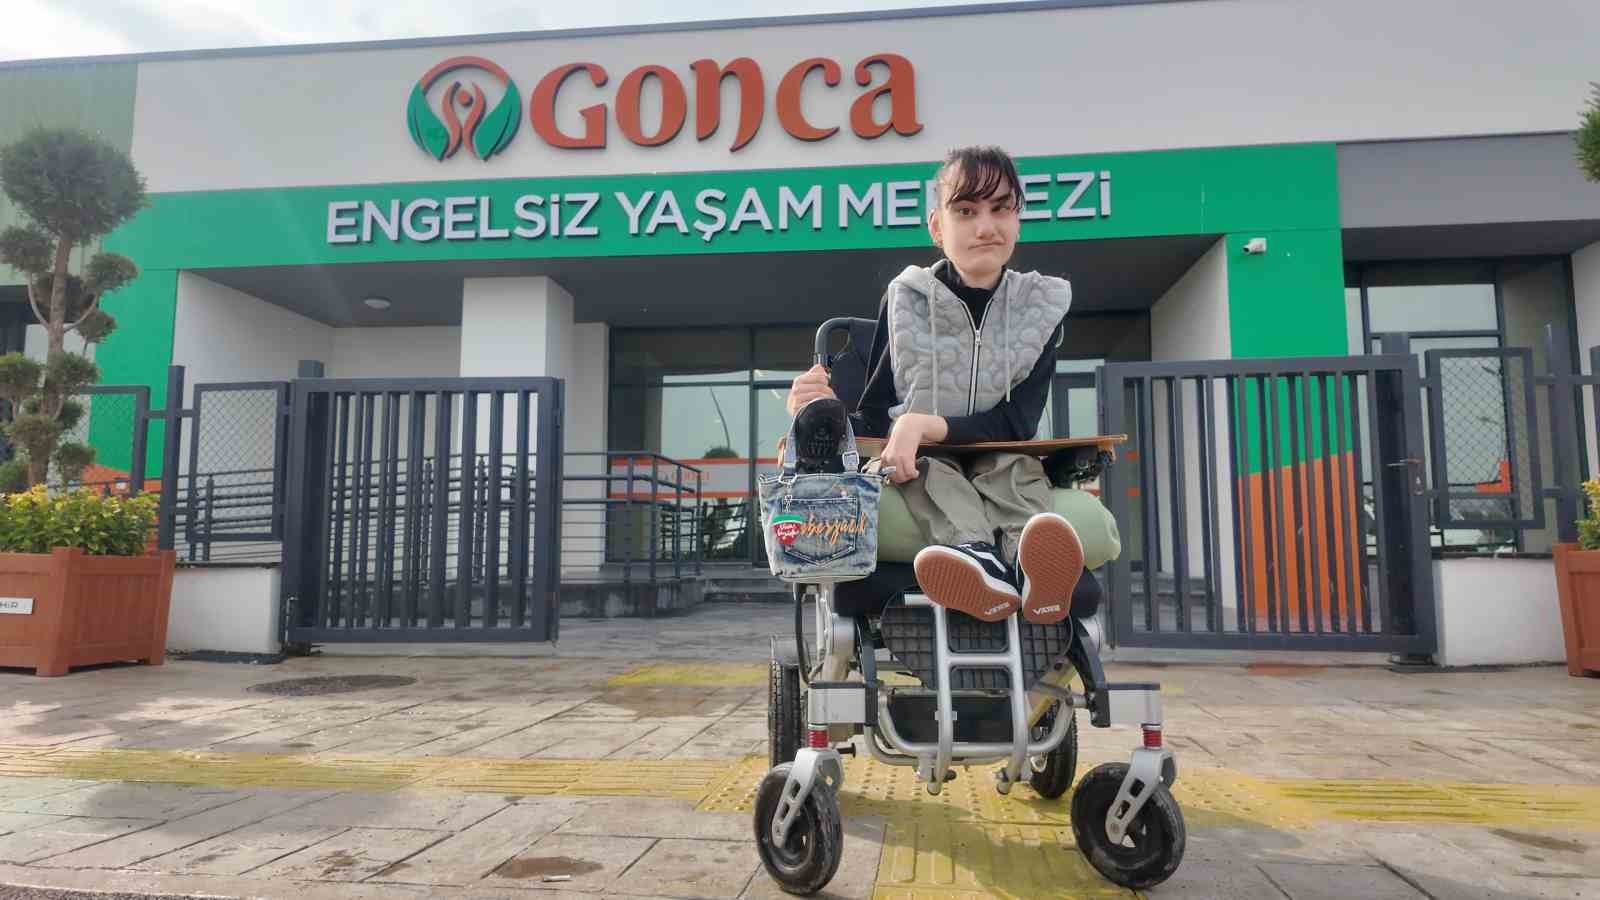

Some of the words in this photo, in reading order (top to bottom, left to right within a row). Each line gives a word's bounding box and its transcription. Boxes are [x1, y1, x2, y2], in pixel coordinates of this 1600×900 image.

[529, 53, 924, 153] Gonca
[614, 185, 823, 241] YAŞAM
[839, 171, 1110, 228] MEEZi
